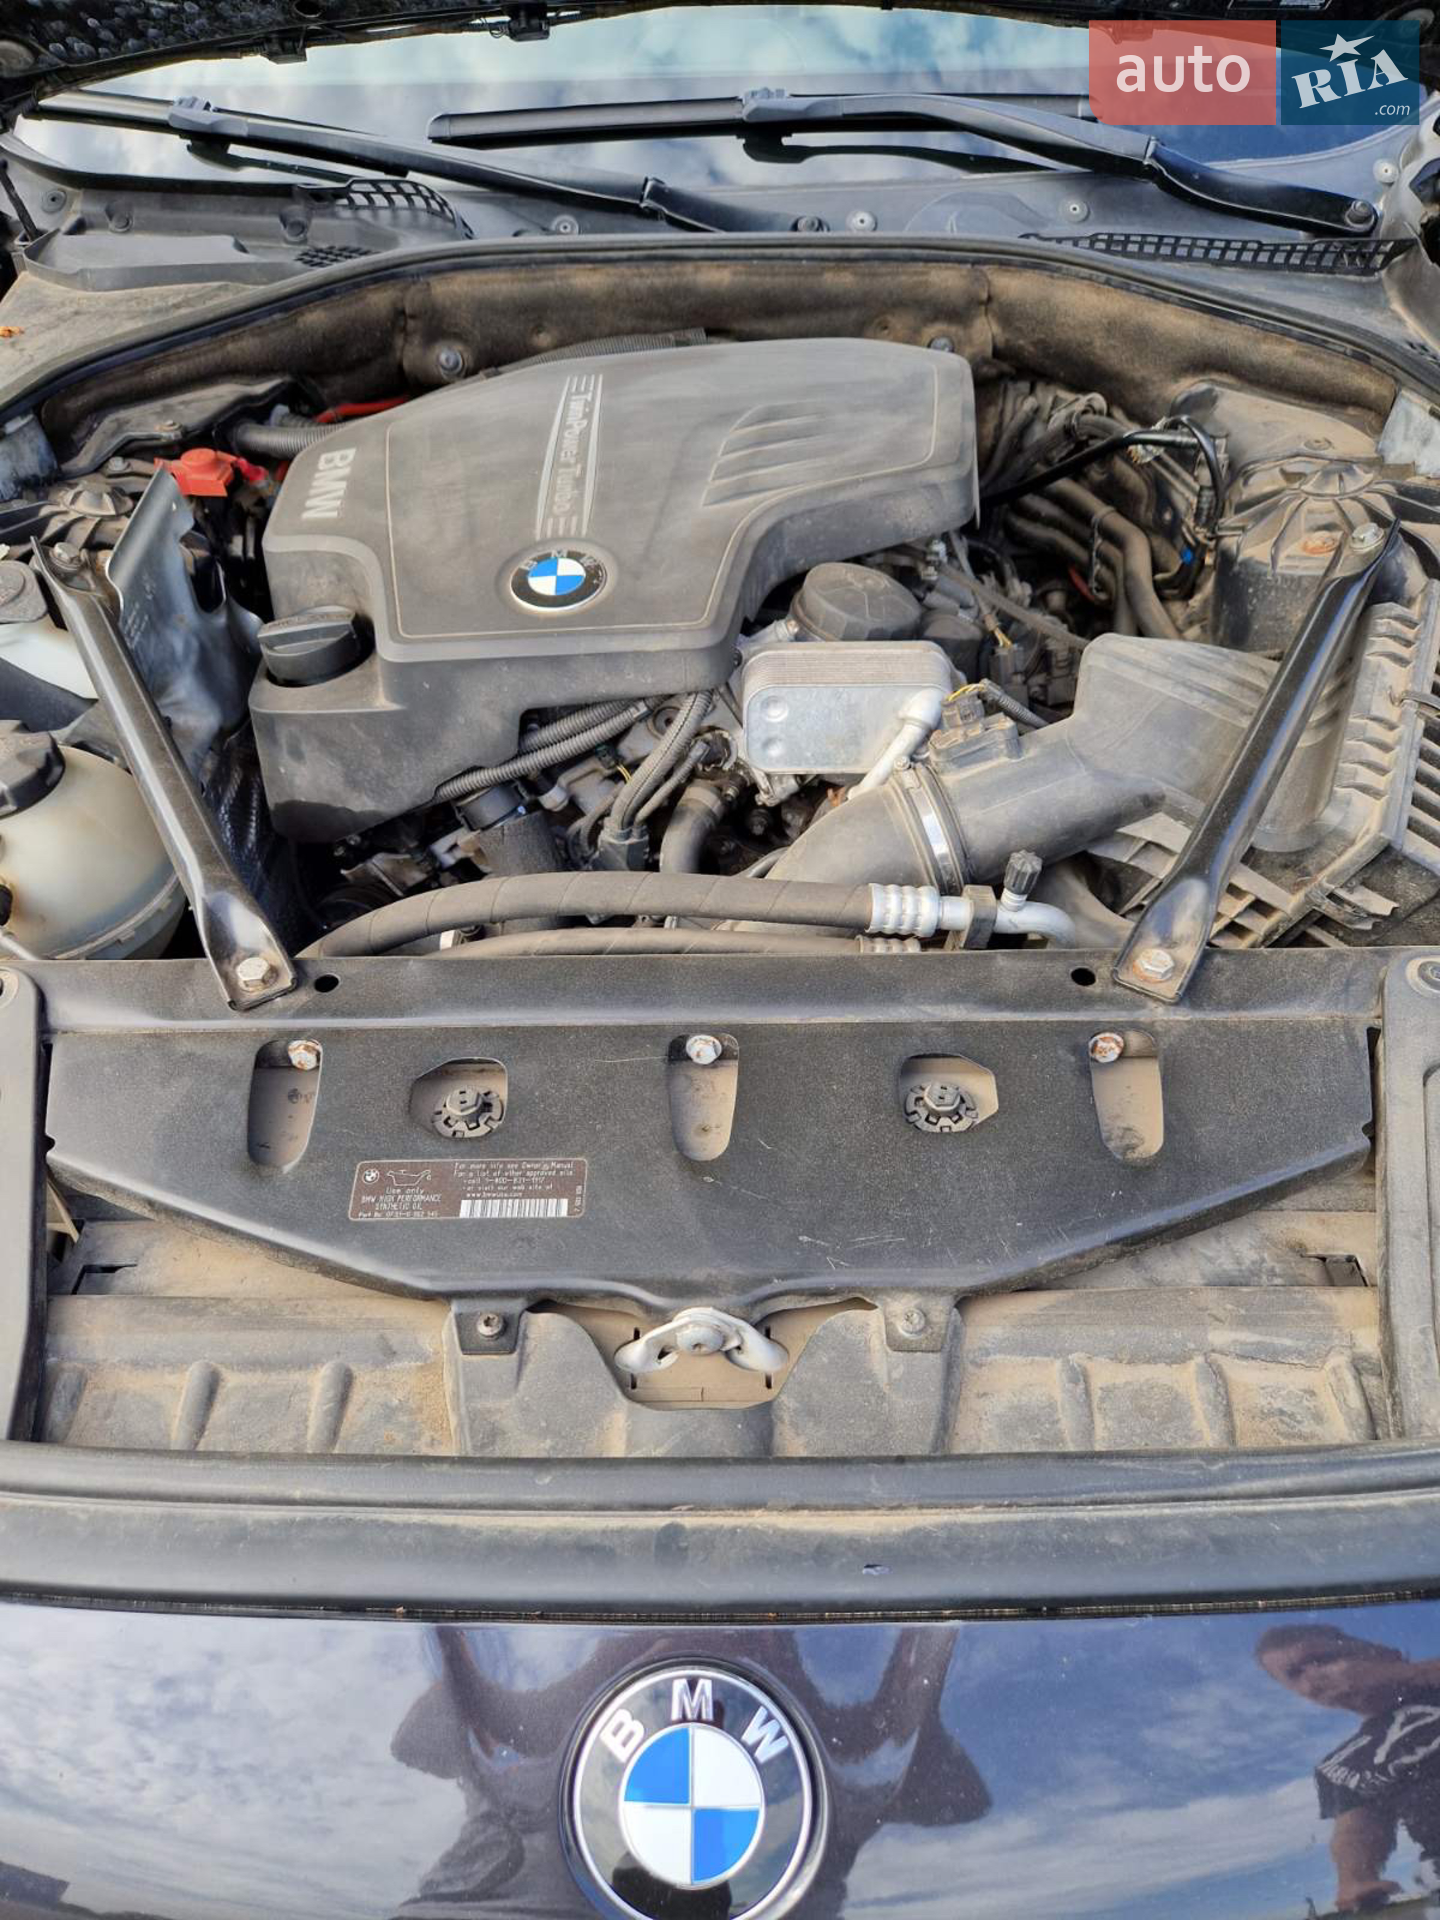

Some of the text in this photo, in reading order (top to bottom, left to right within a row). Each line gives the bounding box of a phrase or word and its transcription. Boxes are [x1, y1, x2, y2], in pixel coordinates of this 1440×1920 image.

[301, 446, 357, 519] BMW
[396, 1193, 442, 1203] PERFORMANCE
[406, 1186, 425, 1196] only
[600, 1677, 789, 1764] BMW
